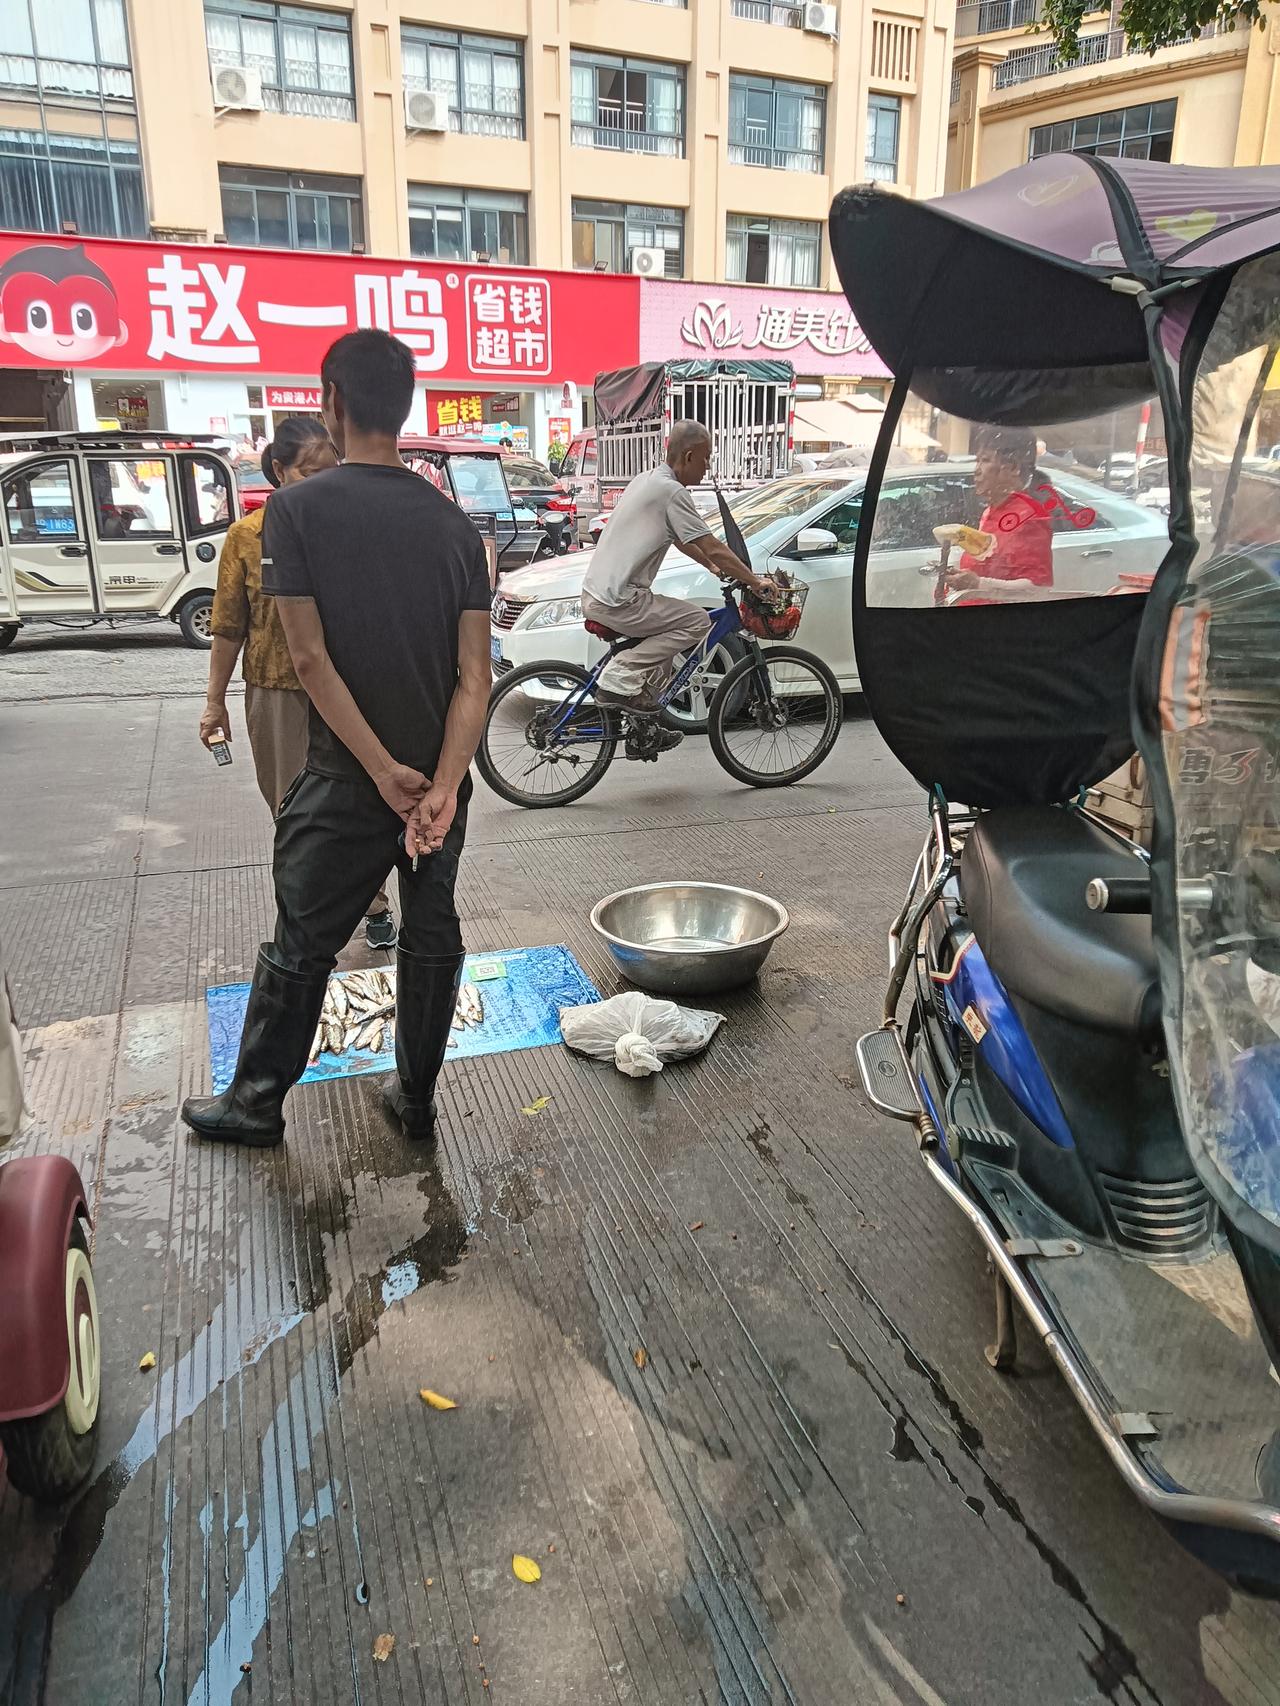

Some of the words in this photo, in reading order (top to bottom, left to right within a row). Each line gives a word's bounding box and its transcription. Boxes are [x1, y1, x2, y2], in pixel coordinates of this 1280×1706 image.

[147, 254, 449, 372] 赵一鸣
[473, 283, 543, 325] 省钱
[475, 326, 546, 367] 超市
[742, 304, 873, 356] 通美针
[437, 395, 483, 425] 省钱
